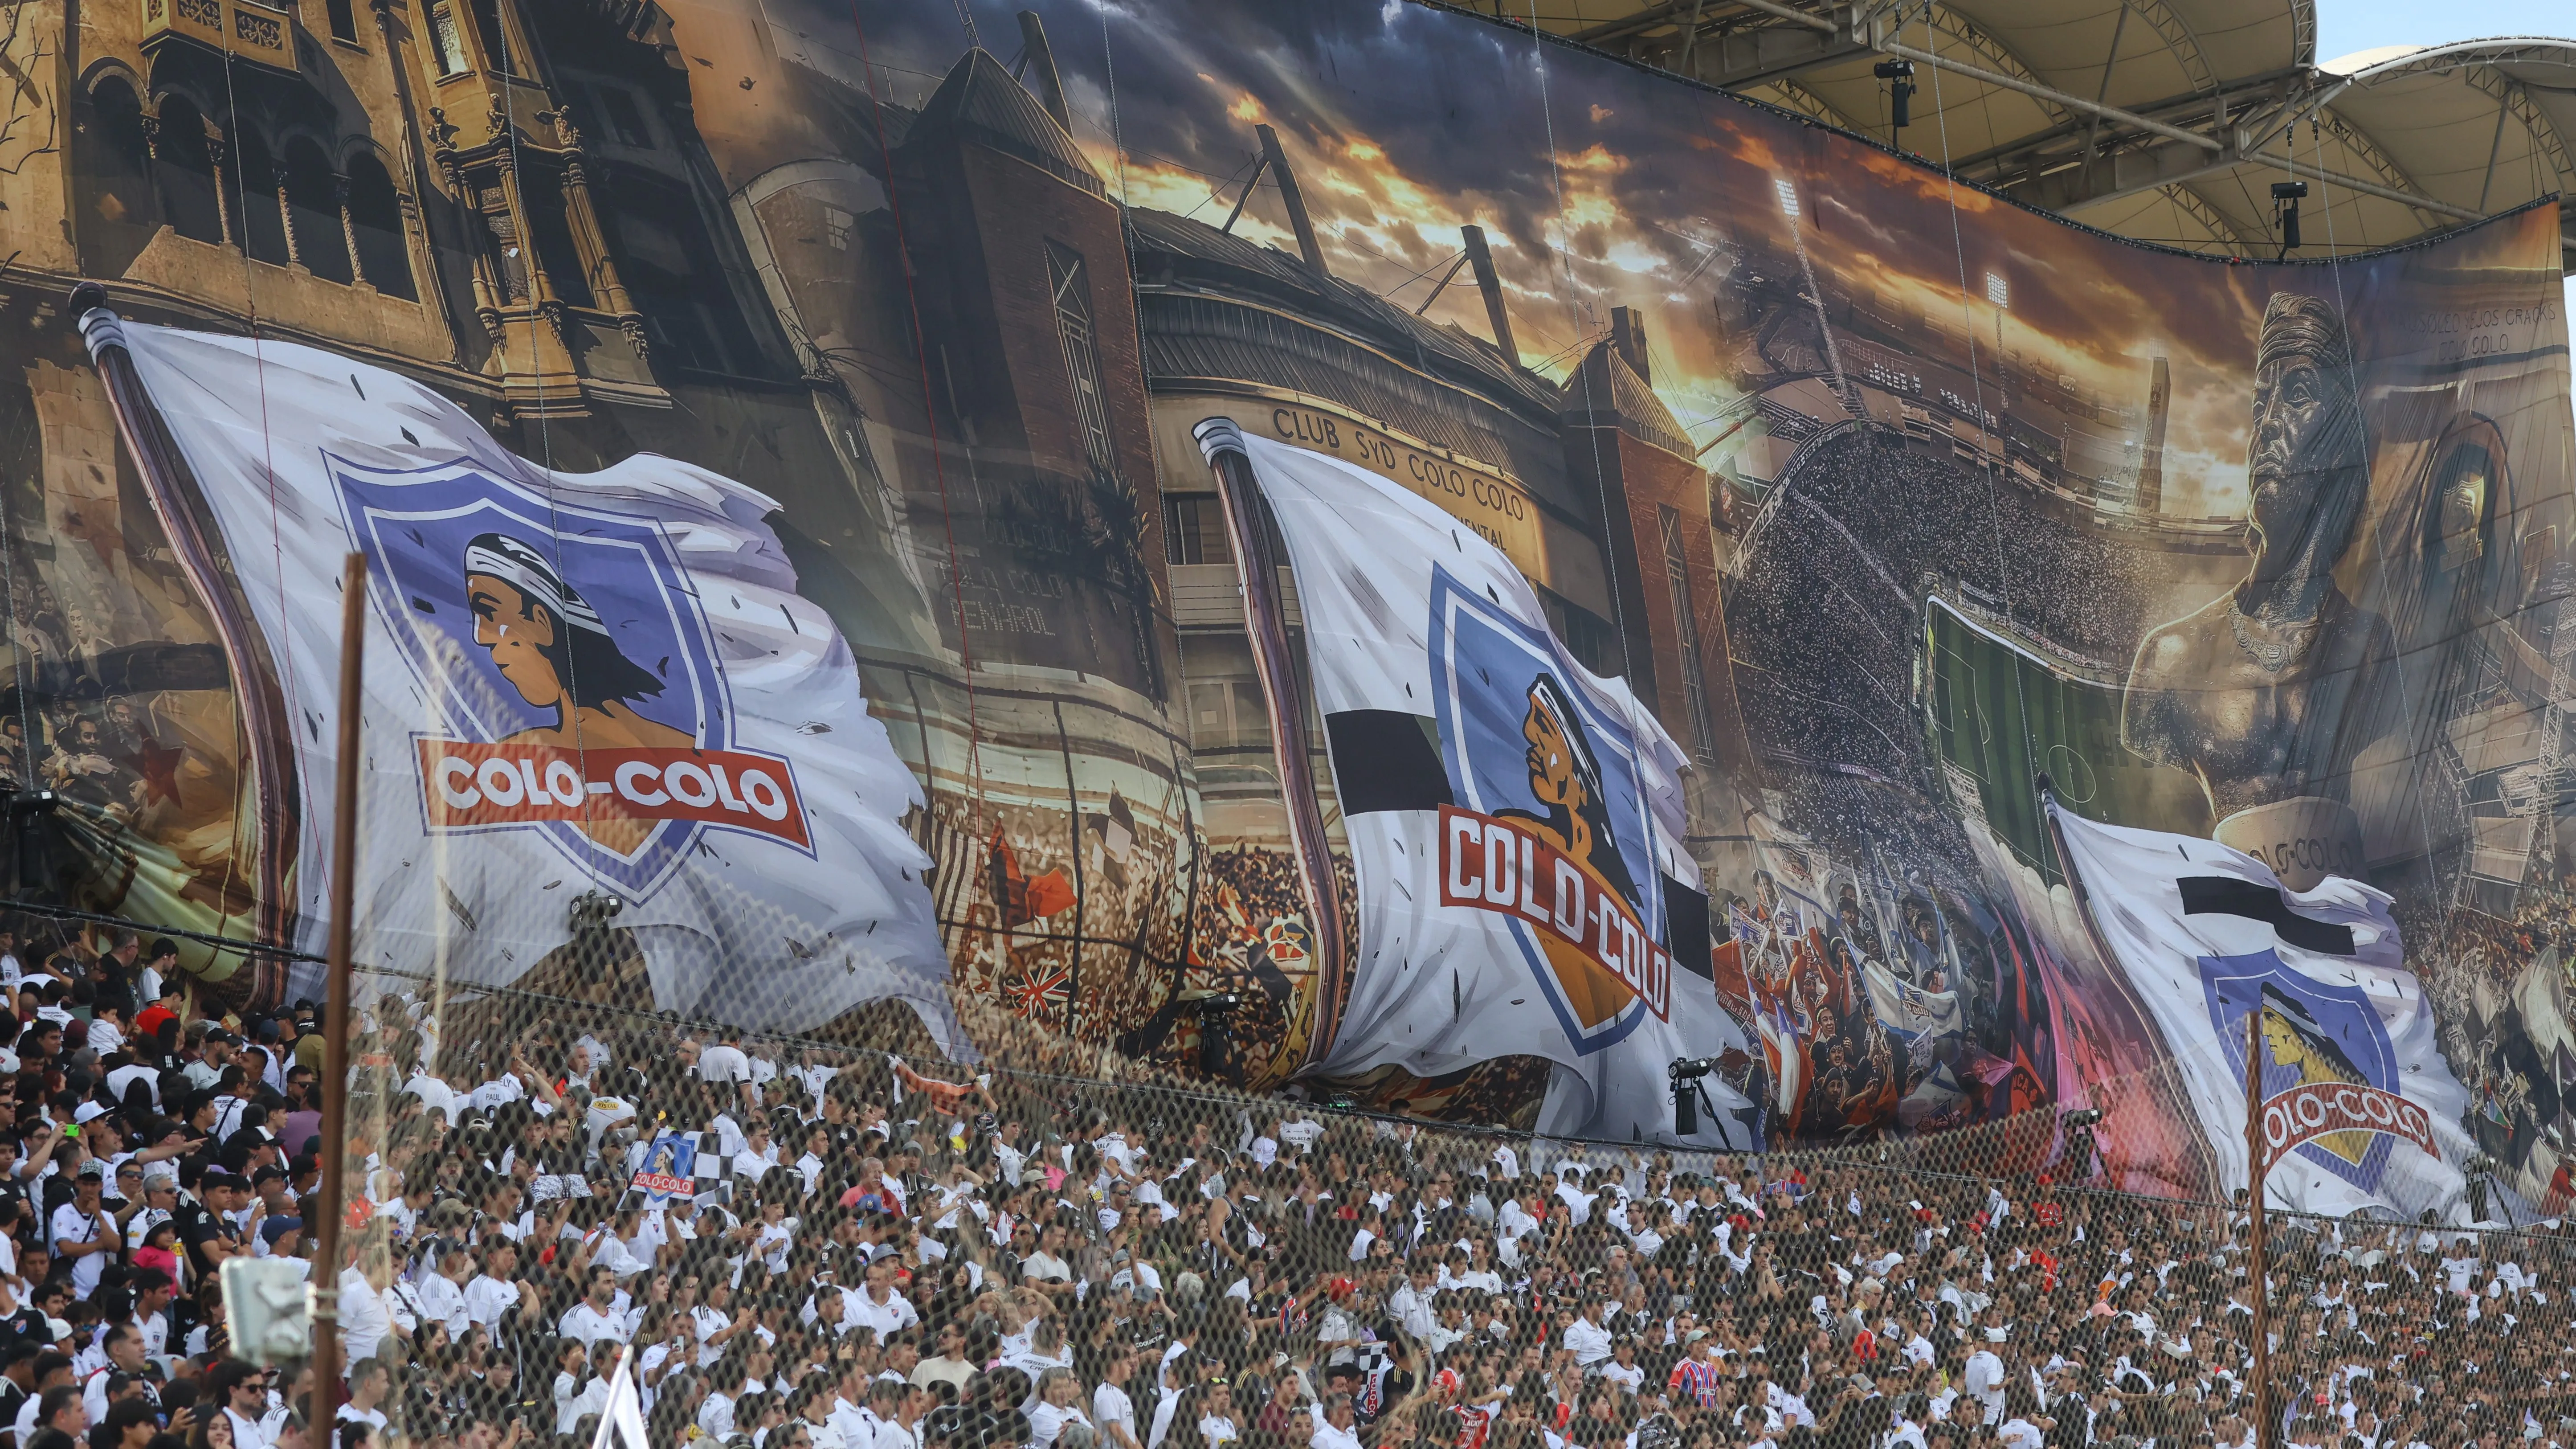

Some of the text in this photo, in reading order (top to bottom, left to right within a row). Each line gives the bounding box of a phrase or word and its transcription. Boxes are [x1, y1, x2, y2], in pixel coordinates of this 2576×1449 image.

[2506, 303, 2556, 325] CRACKS
[2473, 334, 2508, 355] COLO
[1273, 408, 1340, 448] CLUB
[1408, 454, 1465, 497] COLO
[1473, 478, 1523, 521] COLO
[435, 755, 787, 821] COLO-COLO
[2249, 837, 2354, 877] OLO-COLO
[1449, 815, 1666, 1015] COLO-COLO
[595, 1101, 617, 1109] CRISTAL
[634, 1175, 690, 1192] COLO-COLO
[1461, 1417, 1483, 1427] LACIOS
